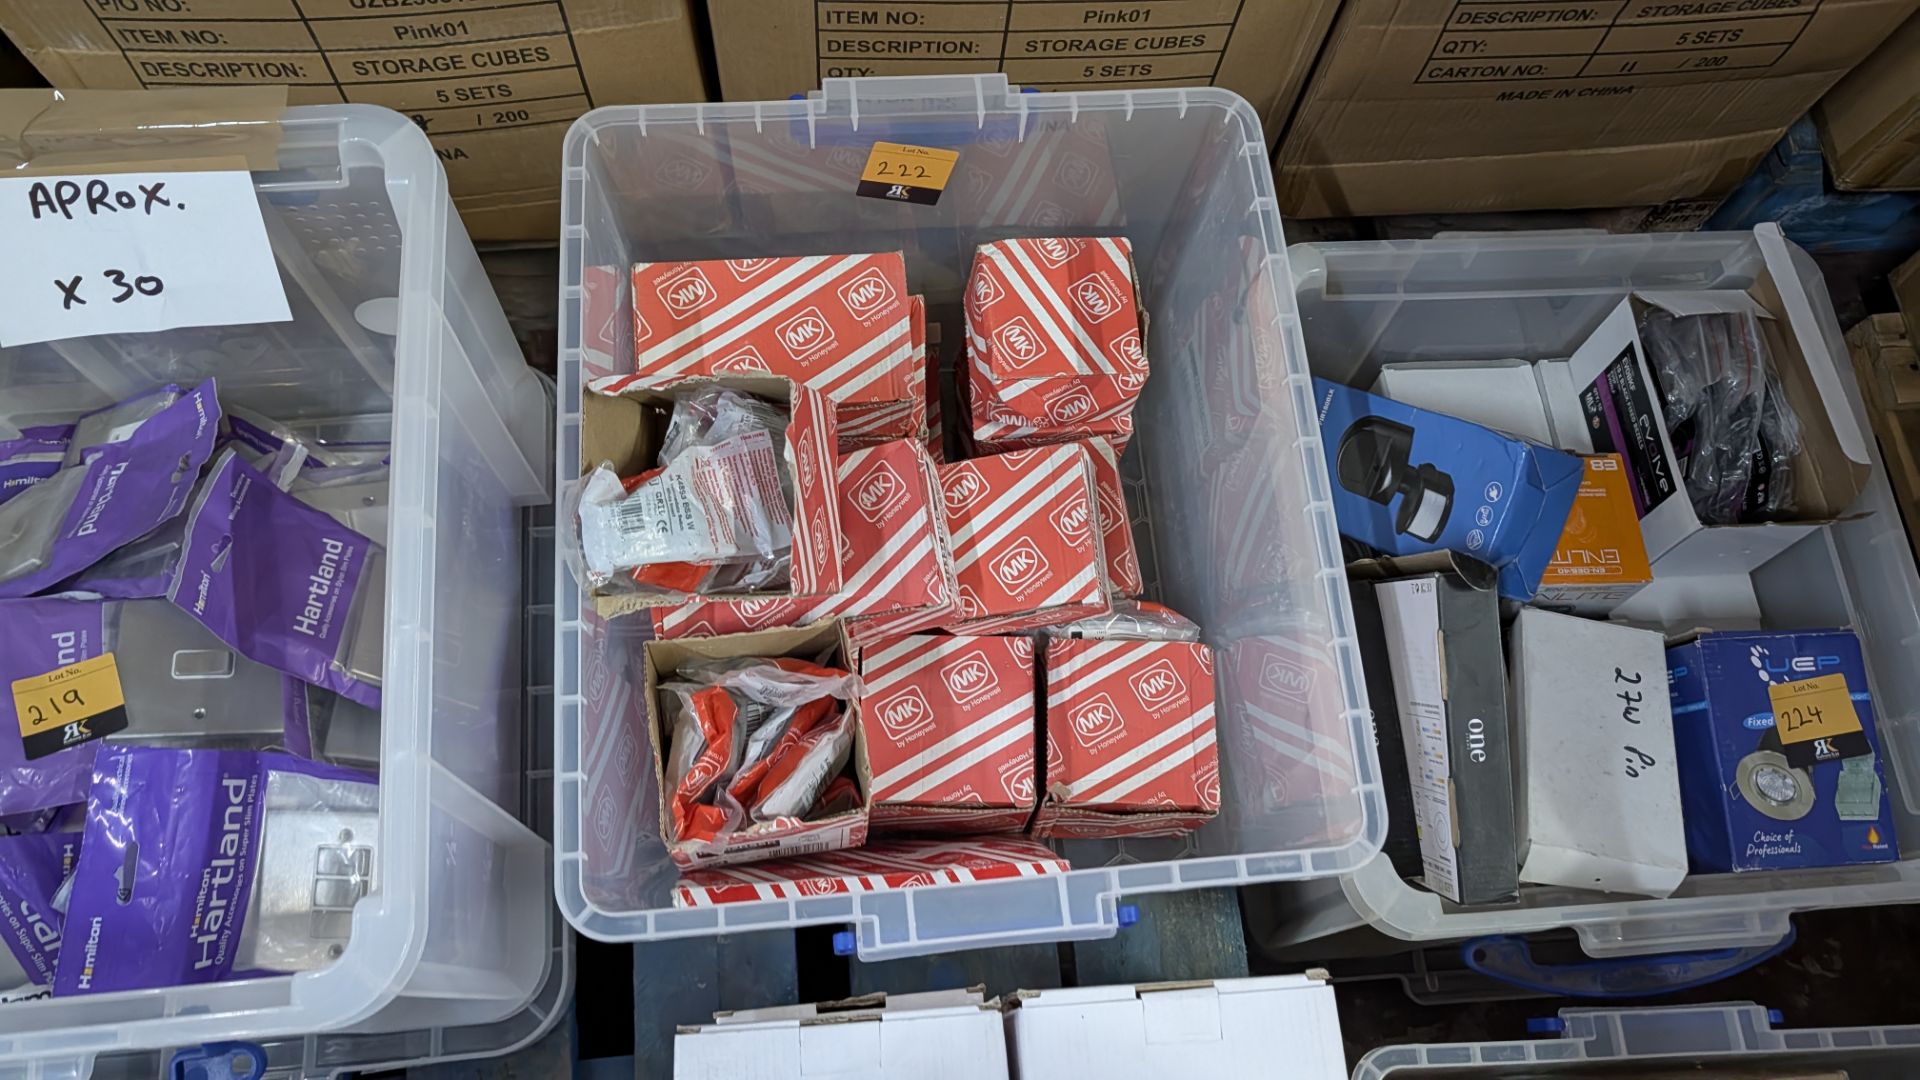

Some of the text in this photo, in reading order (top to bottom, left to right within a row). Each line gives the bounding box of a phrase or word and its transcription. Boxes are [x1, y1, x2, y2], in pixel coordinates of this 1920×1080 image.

[826, 11, 925, 25] ITEM NO:
[1083, 9, 1151, 24] Pink01
[1456, 9, 1600, 24] DESCRIPTION:
[118, 28, 228, 44] ITEM NO:
[393, 20, 469, 40] Pink01
[1676, 29, 1743, 45] 5 SETS
[827, 40, 980, 54] DESCRIPTION:
[1025, 33, 1206, 53] STORAGE CUBES
[1442, 40, 1487, 54] QTY:
[140, 62, 307, 78] DESCRIPTION:
[353, 46, 551, 76] STORAGE CUBES
[1083, 64, 1153, 78] 5 SETS
[1428, 64, 1549, 79] CARTON NO:
[1693, 55, 1728, 67] 200
[436, 84, 513, 102] 5 SETS
[1496, 84, 1636, 102] MADE IN CHINA
[493, 109, 529, 124] 200
[877, 161, 931, 178] 222
[103, 269, 165, 303] 30
[671, 280, 704, 307] MK
[850, 280, 883, 307] MK
[1081, 285, 1107, 313] MK
[788, 320, 820, 347] MK
[863, 319, 871, 328] by
[1006, 328, 1033, 357] MK
[800, 358, 809, 368] by
[1061, 397, 1087, 419] MK
[862, 475, 893, 507] MK
[946, 475, 977, 504] MK
[1002, 550, 1035, 581] MK
[1550, 549, 1620, 564] ENLIT
[293, 537, 344, 636] Hartland
[1016, 592, 1025, 602] by
[48, 668, 82, 683] Lot No.
[953, 664, 985, 690] MK
[1141, 672, 1172, 697] MK
[962, 687, 1001, 712] by Honeywell
[1793, 684, 1806, 692] Lot
[28, 689, 85, 726] 219
[888, 699, 920, 725] MK
[1152, 695, 1190, 720] by Honeywell
[1781, 705, 1823, 732] 224
[1078, 706, 1110, 733] MK
[1747, 716, 1773, 727] Fixed
[896, 723, 936, 749] by Honeywell
[1089, 729, 1128, 756] by Honeywell
[1467, 718, 1486, 763] one
[1753, 829, 1794, 844] Choice of
[1746, 843, 1801, 858] Professionals
[194, 778, 248, 970] Hartland
[215, 774, 258, 965] Quality Accessories on Super Slim Plates
[190, 867, 211, 938] Hamilton
[16, 926, 35, 951] Super
[31, 951, 47, 973] Slim
[78, 917, 103, 989] Hamilton
